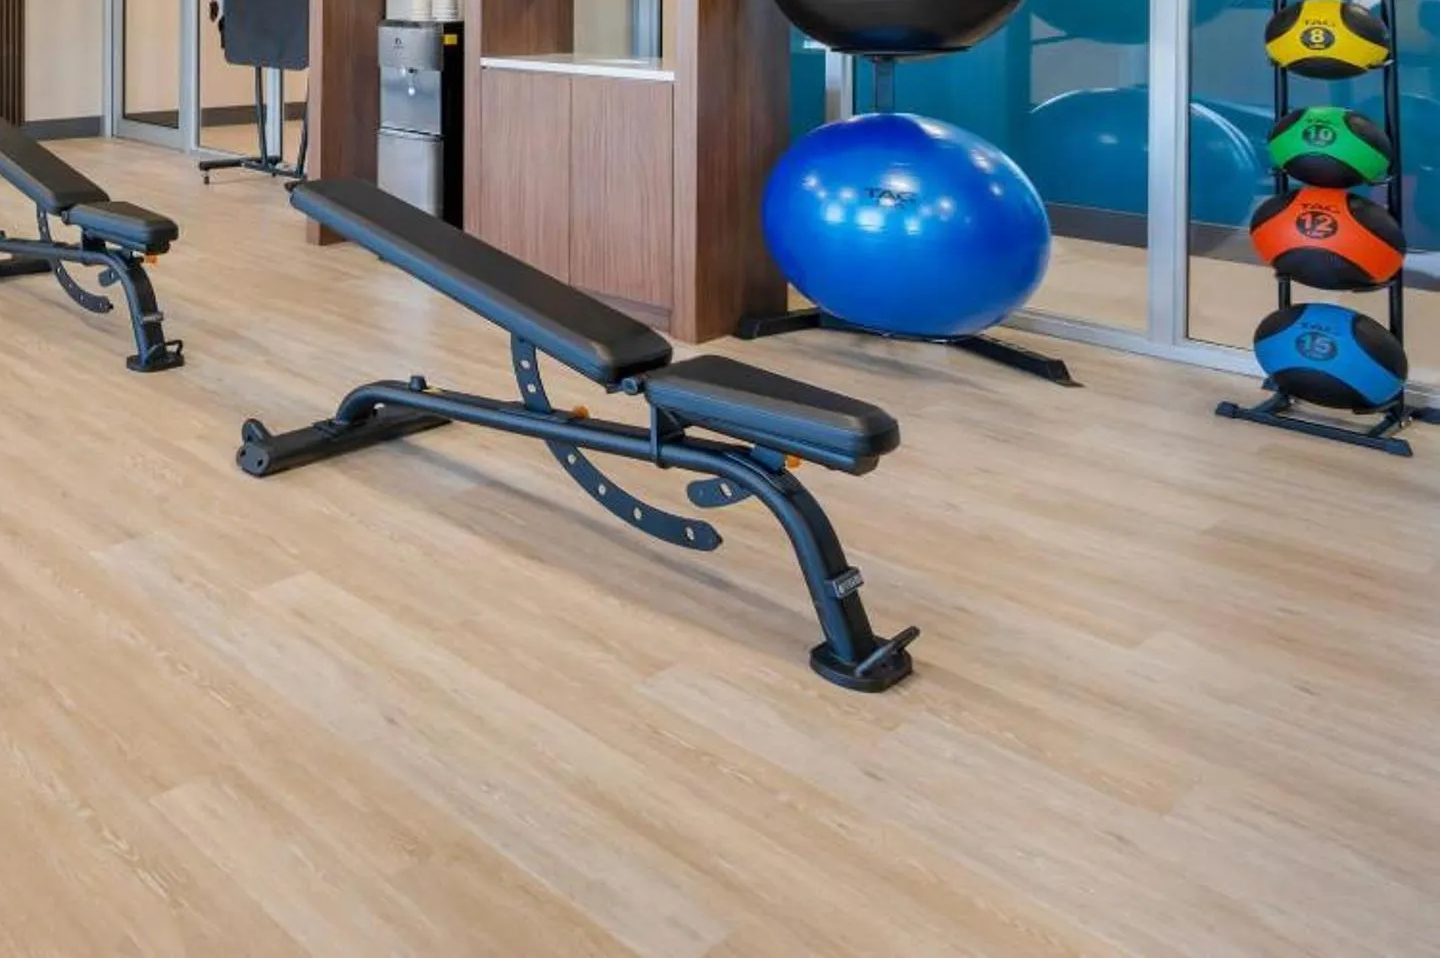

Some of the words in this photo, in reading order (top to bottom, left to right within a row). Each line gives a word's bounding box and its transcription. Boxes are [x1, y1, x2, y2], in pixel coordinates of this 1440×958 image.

[1310, 28, 1325, 43] 8
[1308, 127, 1333, 141] 10
[1301, 213, 1333, 232] 12
[1301, 334, 1330, 353] 15
